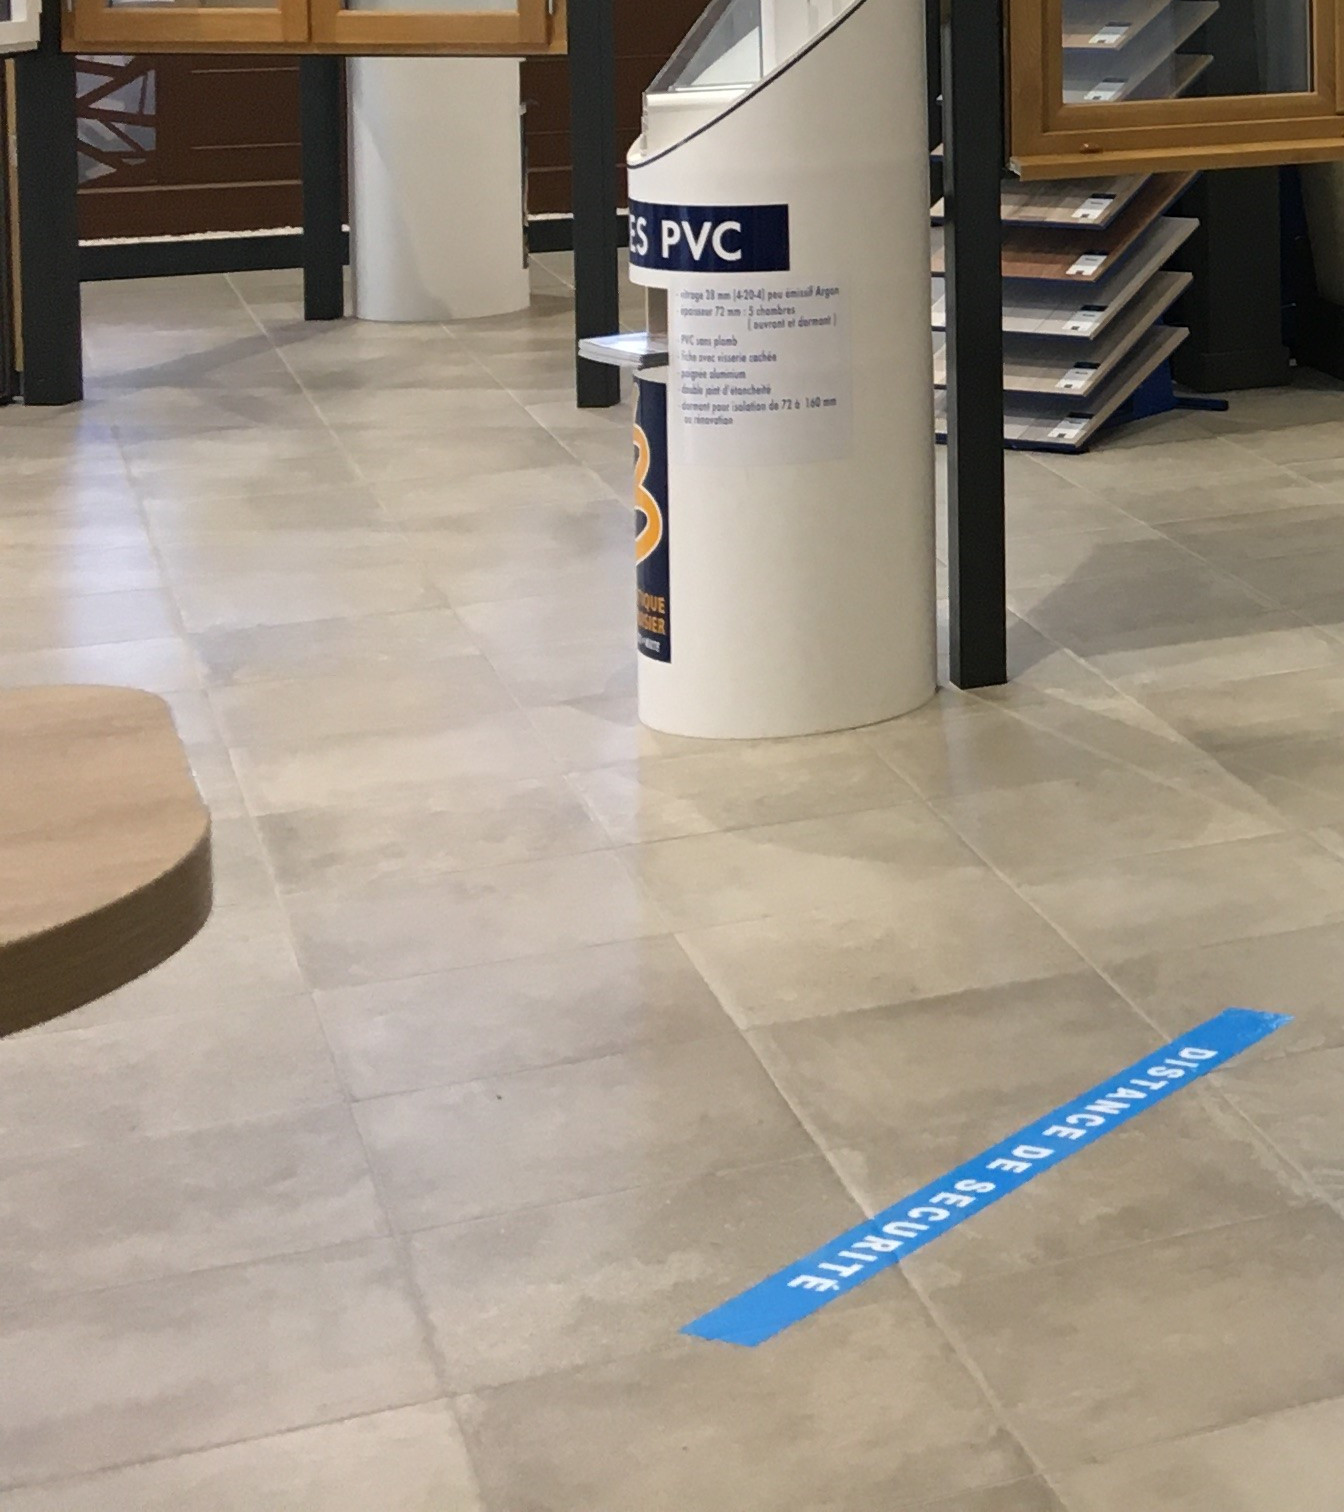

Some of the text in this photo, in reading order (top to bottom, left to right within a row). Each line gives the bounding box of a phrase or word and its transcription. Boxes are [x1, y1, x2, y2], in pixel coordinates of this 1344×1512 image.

[661, 220, 742, 261] PVC
[815, 286, 839, 299] Argon
[715, 306, 725, 317] 72
[756, 304, 796, 316] chambres
[781, 398, 792, 410] 72
[787, 1046, 1218, 1292] DISTANCE DE SECURITÉ
